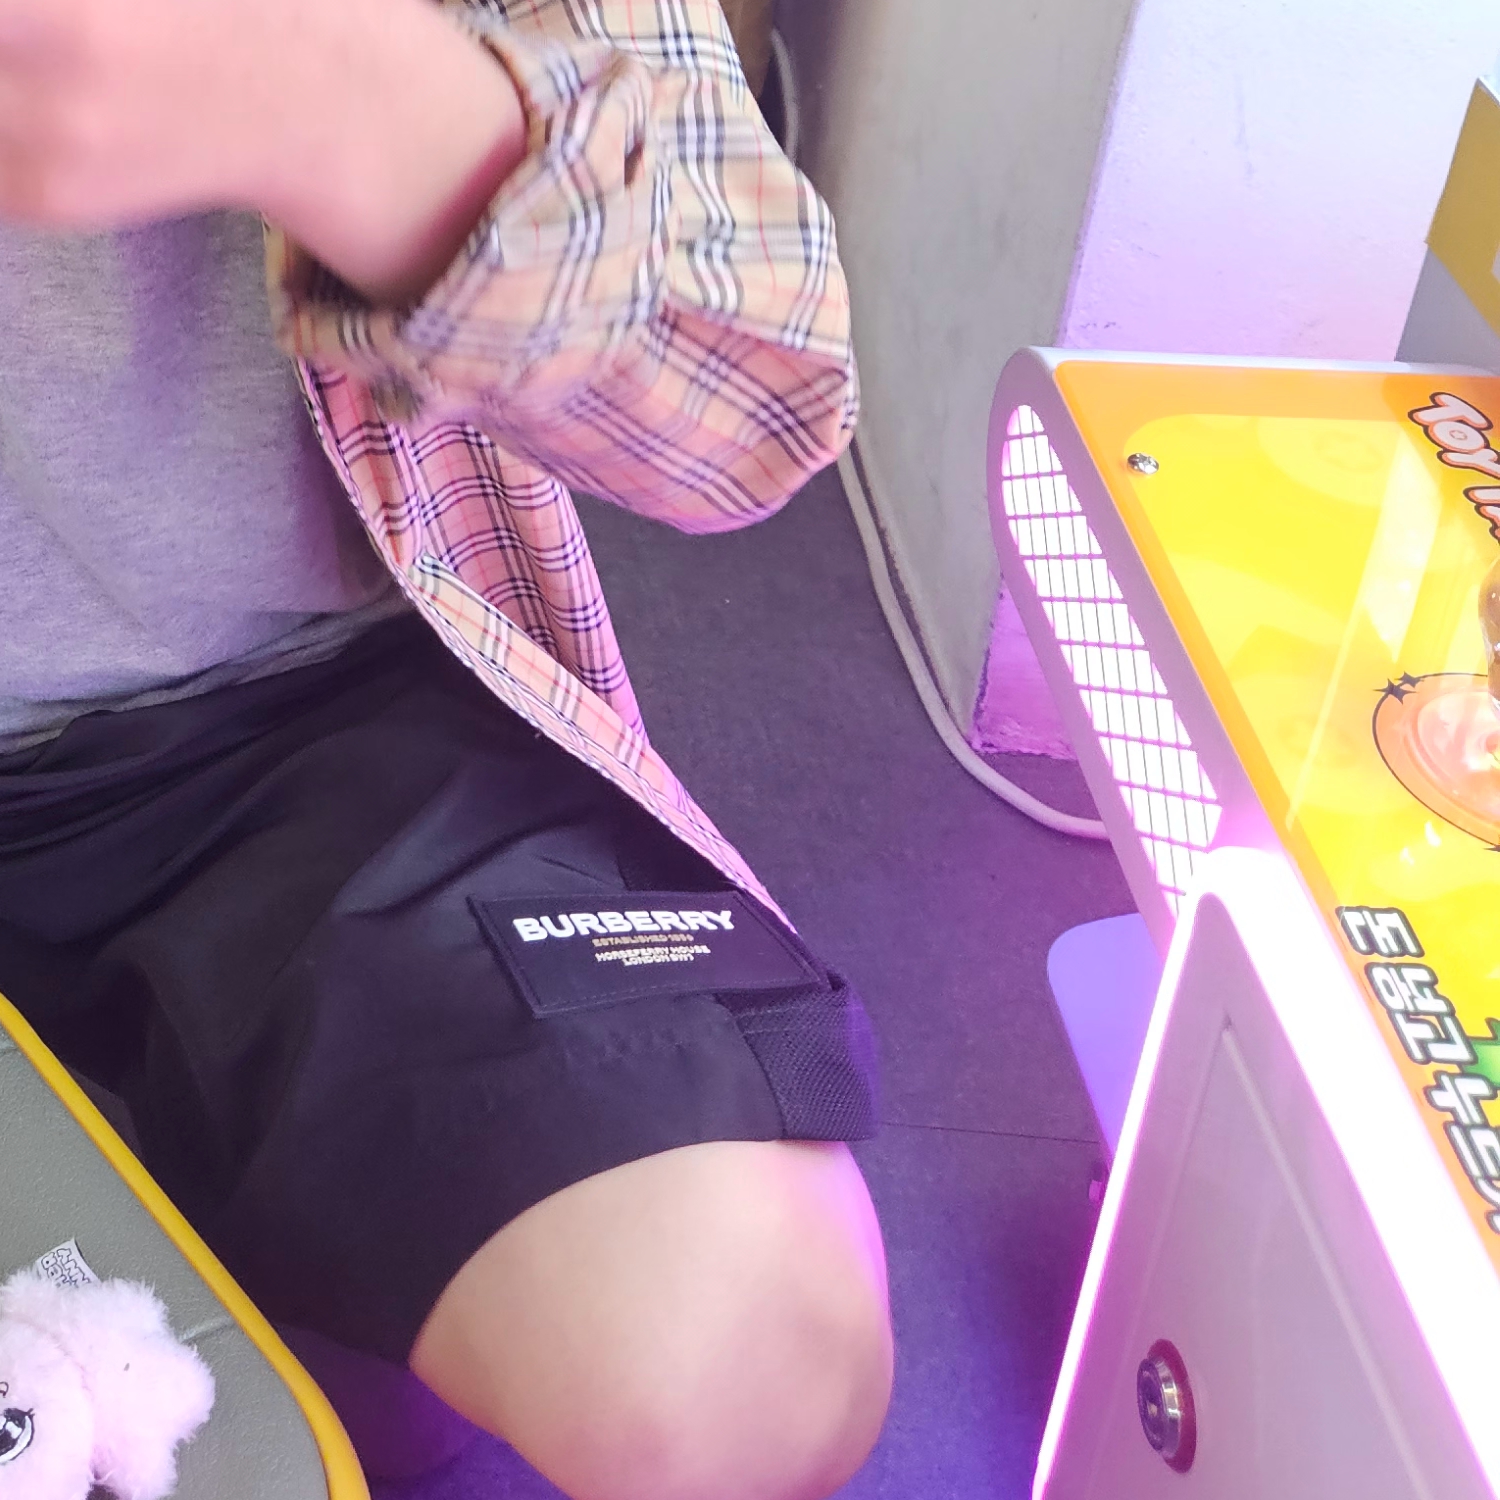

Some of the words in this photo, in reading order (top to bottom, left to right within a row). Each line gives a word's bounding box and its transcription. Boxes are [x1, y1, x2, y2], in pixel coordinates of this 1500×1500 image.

[1408, 392, 1500, 480] TOY
[513, 911, 735, 941] BURBERRY
[592, 934, 668, 947] ESTABLISHED
[1336, 906, 1425, 958] 돈
[1364, 962, 1477, 1064] 넣고
[1424, 1070, 1500, 1235] 누르
